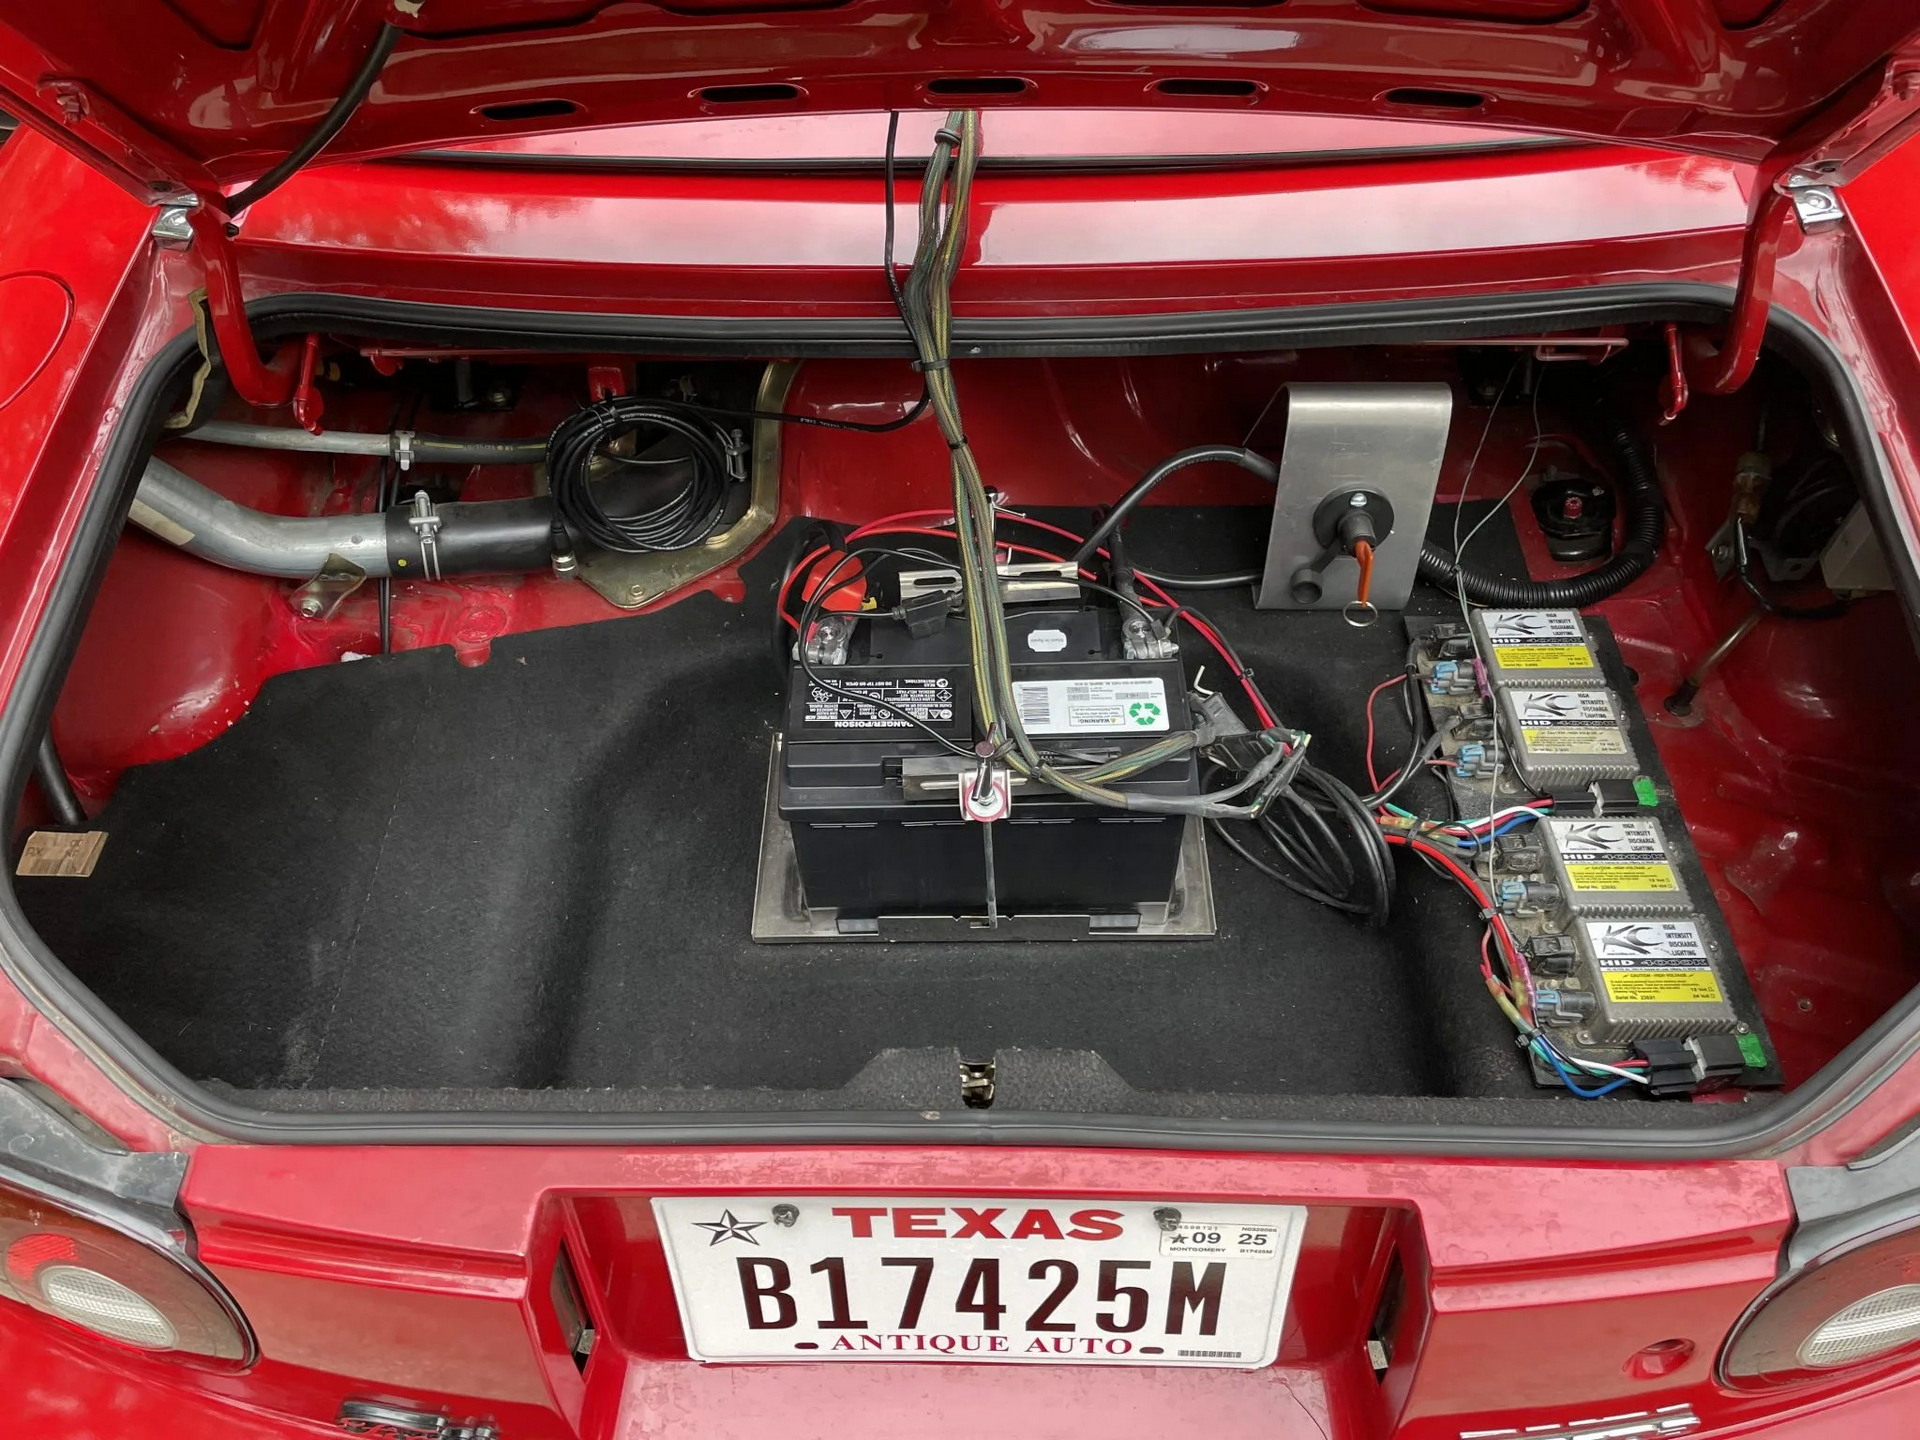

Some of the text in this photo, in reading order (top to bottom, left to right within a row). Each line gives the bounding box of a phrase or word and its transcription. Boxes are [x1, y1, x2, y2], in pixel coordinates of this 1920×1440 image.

[1494, 614, 1547, 635] KC
[1523, 693, 1578, 716] KC
[1565, 823, 1624, 850] KC
[1602, 925, 1664, 955] KC
[831, 1207, 1125, 1241] TEXAS
[1192, 1232, 1268, 1245] 09 25
[735, 1256, 1227, 1336] B17425M
[830, 1334, 1133, 1355] ANTIQUE AUTO
